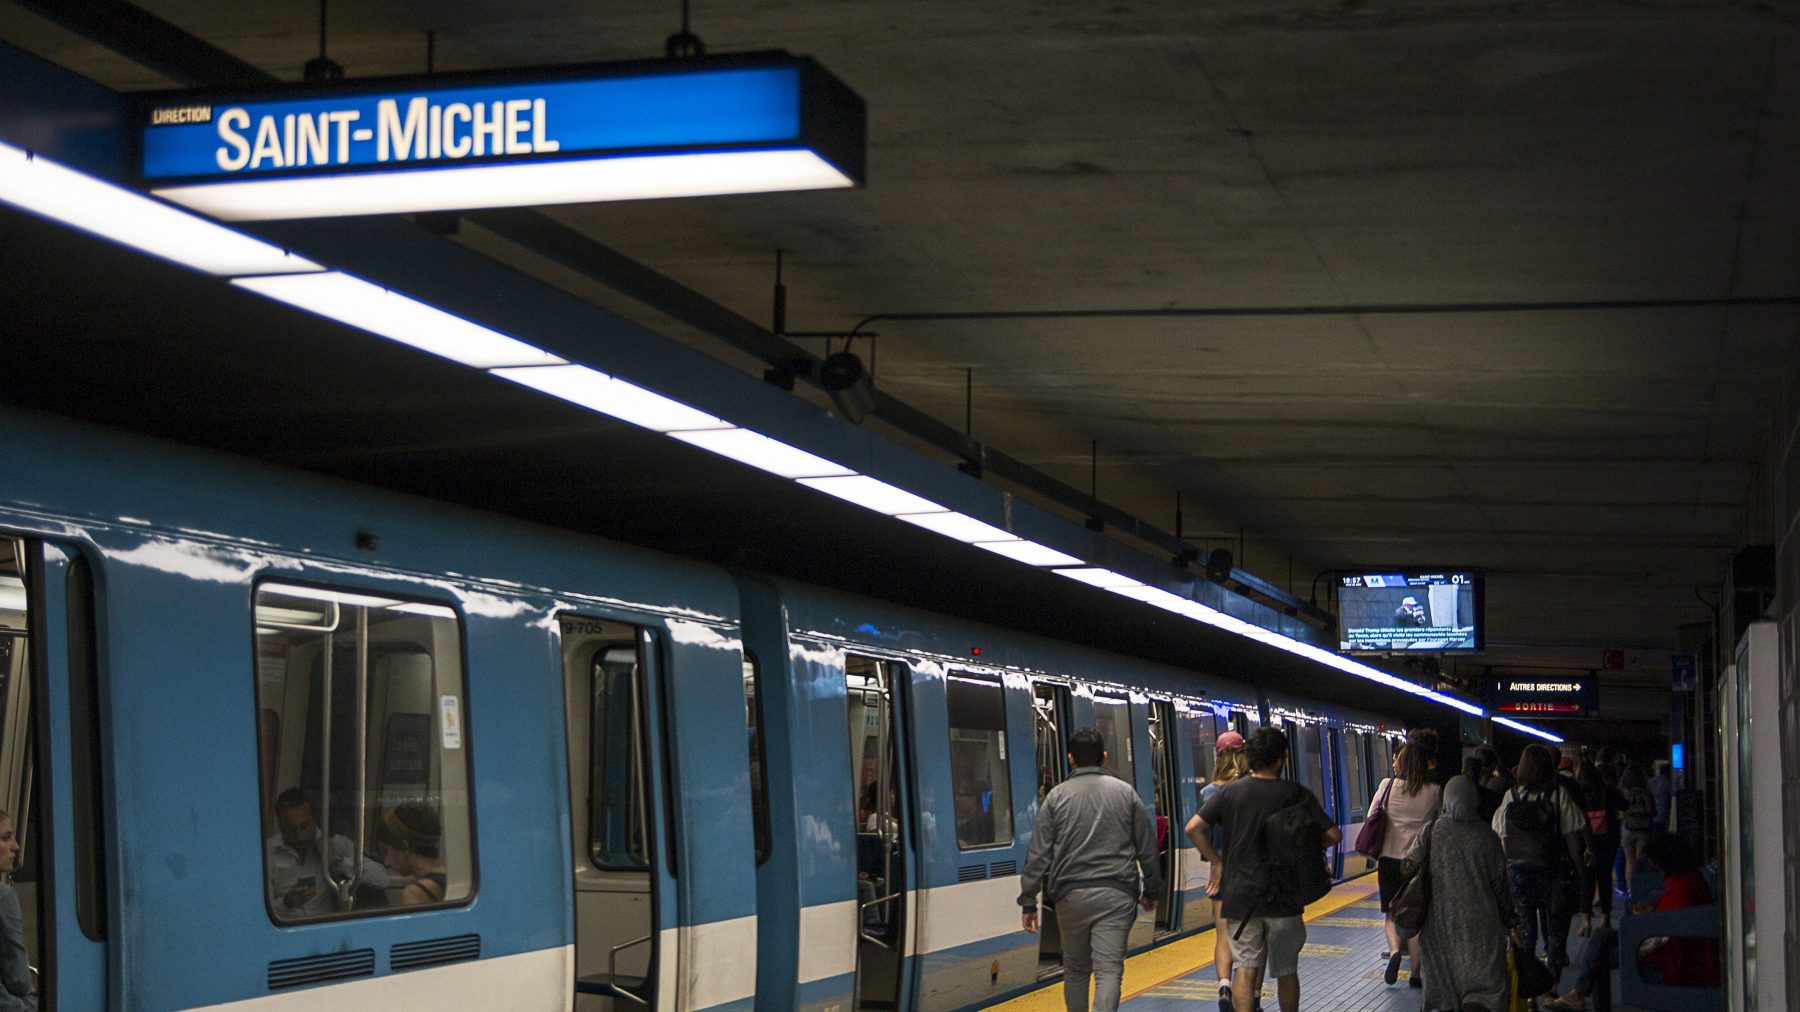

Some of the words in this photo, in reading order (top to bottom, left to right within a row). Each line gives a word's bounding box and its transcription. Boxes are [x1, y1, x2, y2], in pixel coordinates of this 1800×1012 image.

[151, 104, 213, 125] DIRECTION
[215, 96, 561, 172] SAINT-MICHEL
[1451, 574, 1464, 584] 01
[1509, 682, 1536, 691] AUTRES
[1536, 683, 1573, 692] DIRECTIONS
[1515, 702, 1554, 711] SORTIE
